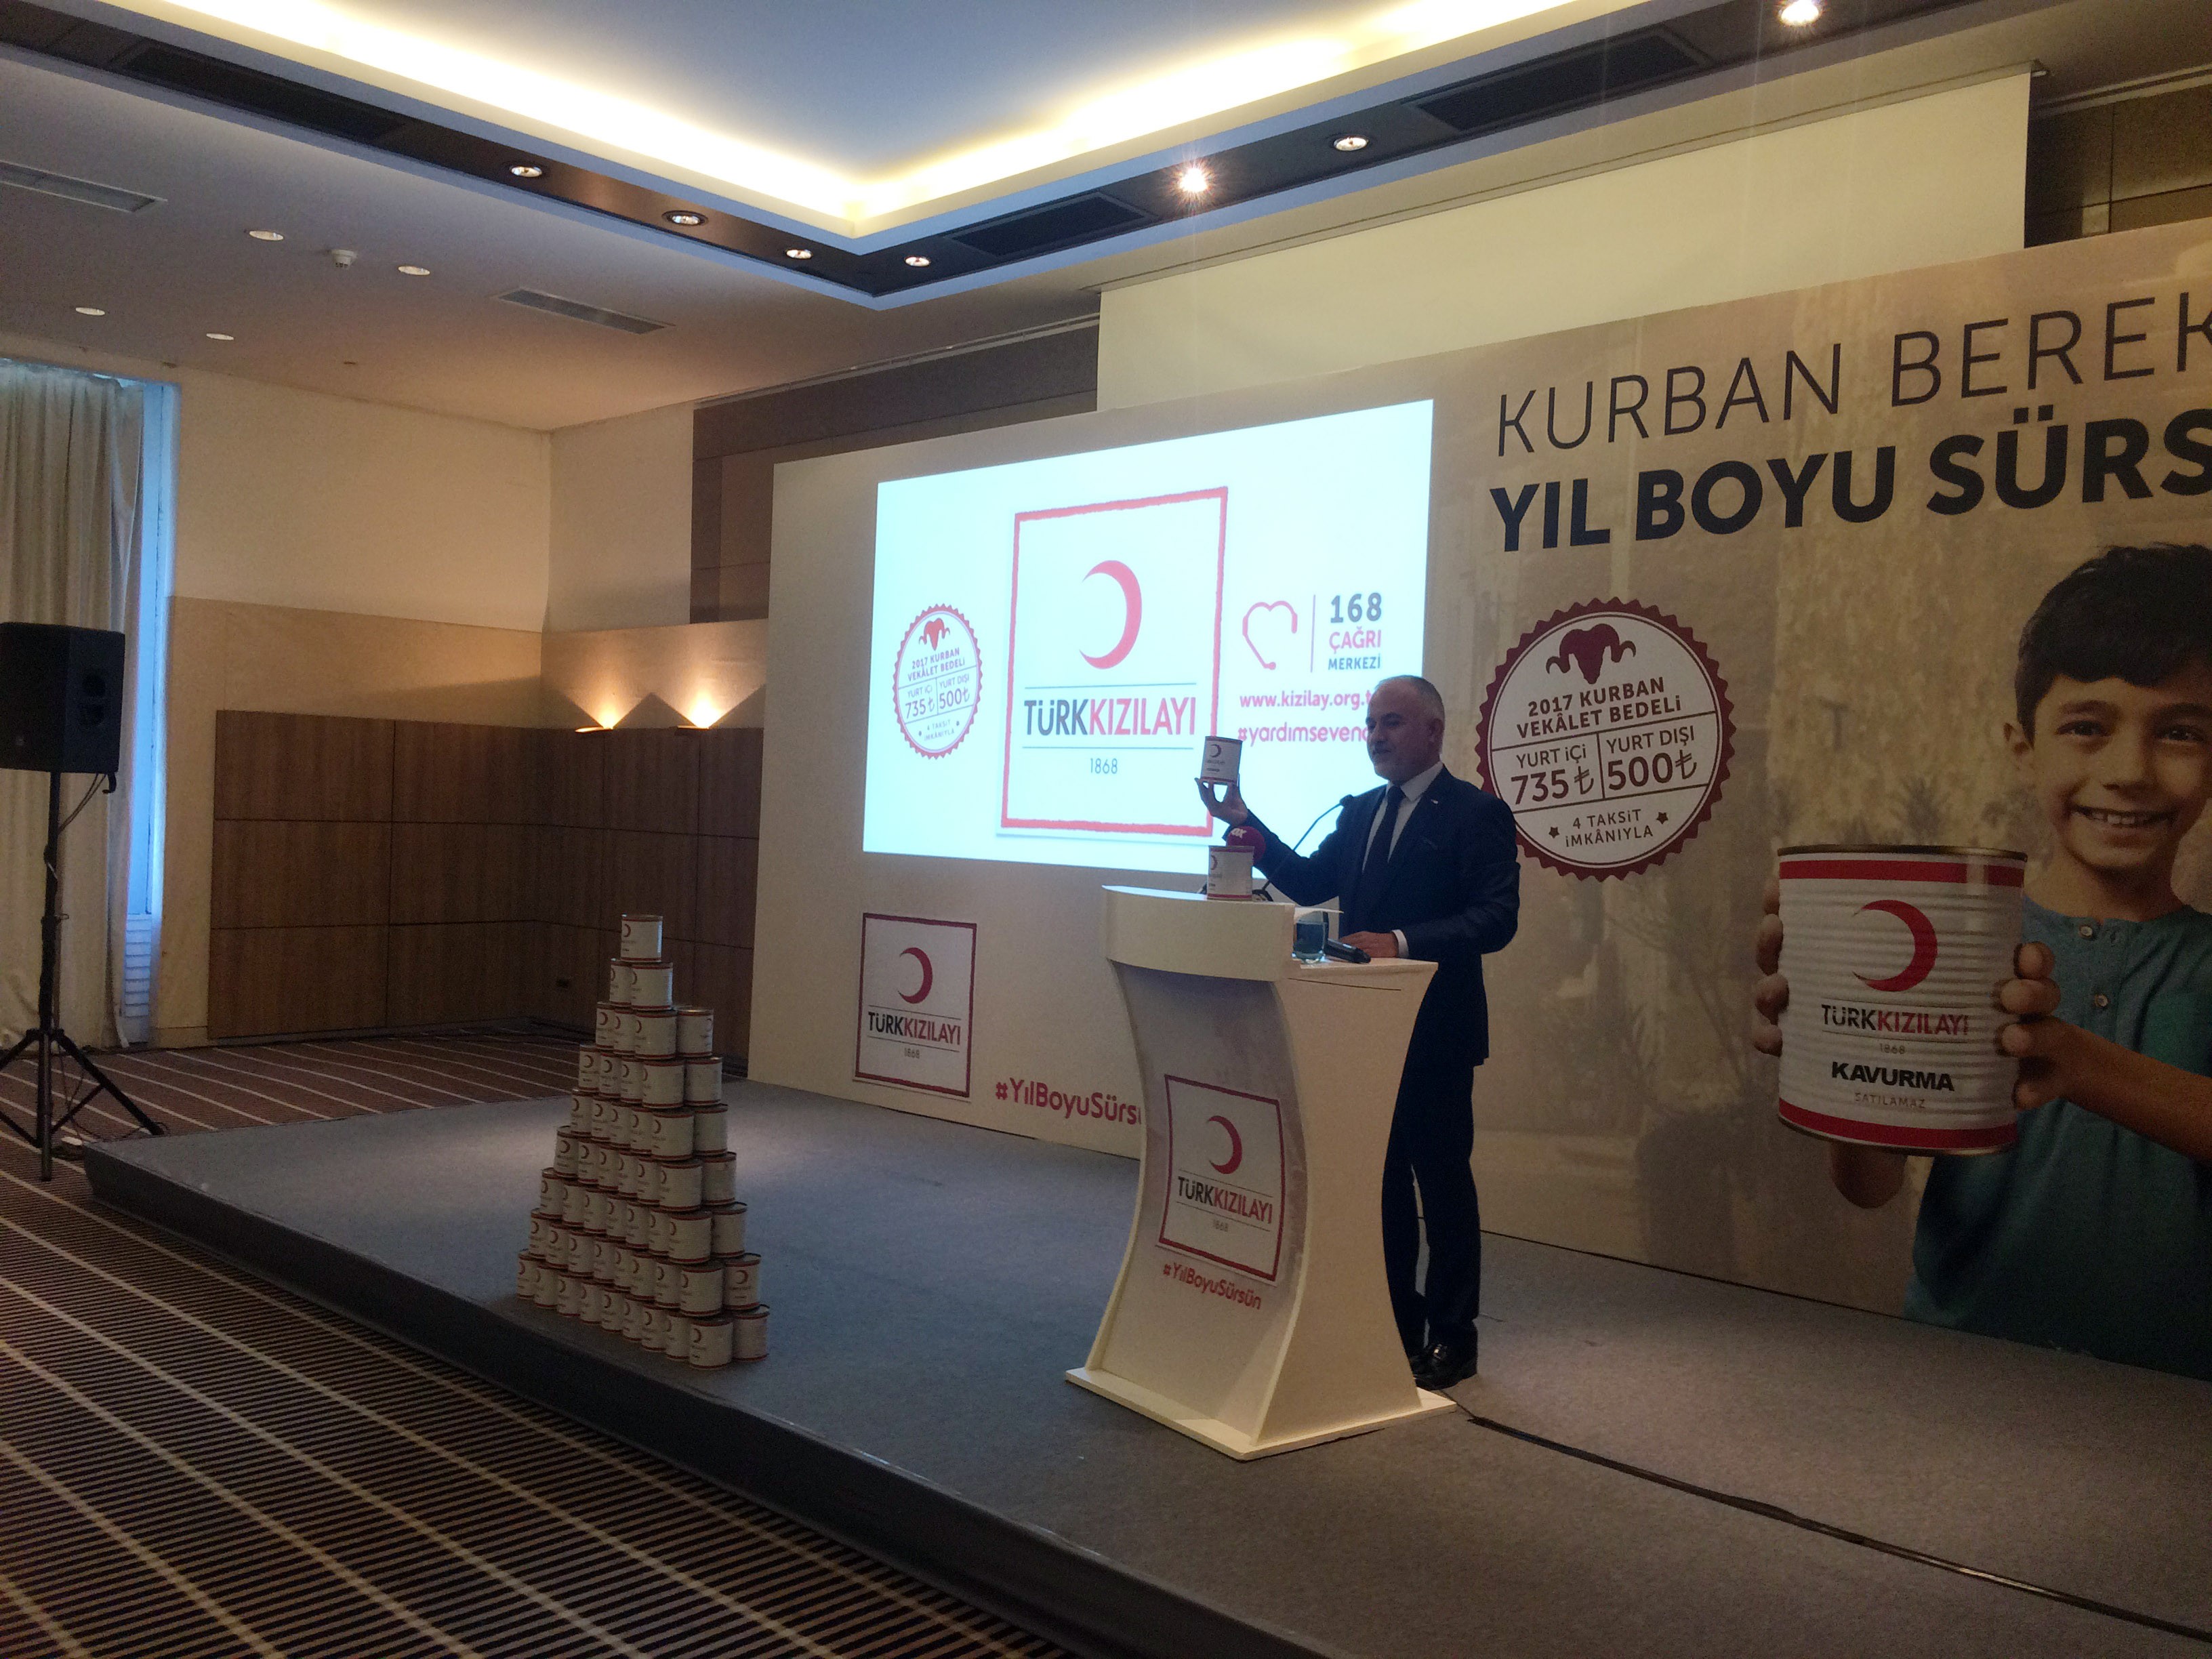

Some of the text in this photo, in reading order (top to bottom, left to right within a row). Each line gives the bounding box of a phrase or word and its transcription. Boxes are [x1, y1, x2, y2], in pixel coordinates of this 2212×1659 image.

[1497, 292, 2212, 456] KURBAN BEREK
[1490, 405, 2212, 552] YIL BOYU SÜRS
[1330, 592, 1382, 623] 168
[1329, 626, 1381, 653] ÇAĞRI
[912, 647, 960, 670] 2017 KURBAN
[1328, 653, 1380, 670] MERKEZİ
[939, 677, 956, 689] YURT
[1528, 677, 1664, 717] 2017 KURBAN
[1024, 697, 1196, 735] TÜRKKIZILAYI
[1517, 695, 1681, 739] VEKÂLET BEDELİ
[1607, 726, 1694, 754] YURT DIŞI
[1090, 758, 1118, 775] 1868
[1516, 744, 1586, 768] YURT İÇİ
[1572, 808, 1641, 830] 4 TAKSİT
[1565, 825, 1653, 848] İMKÂNIYLA
[1879, 1042, 1906, 1054] 1868
[1832, 1061, 1955, 1092] KAVURMA
[1855, 1092, 1926, 1109] SATILAMAZ
[1163, 1262, 1262, 1310] #YılBoyuSürsün
